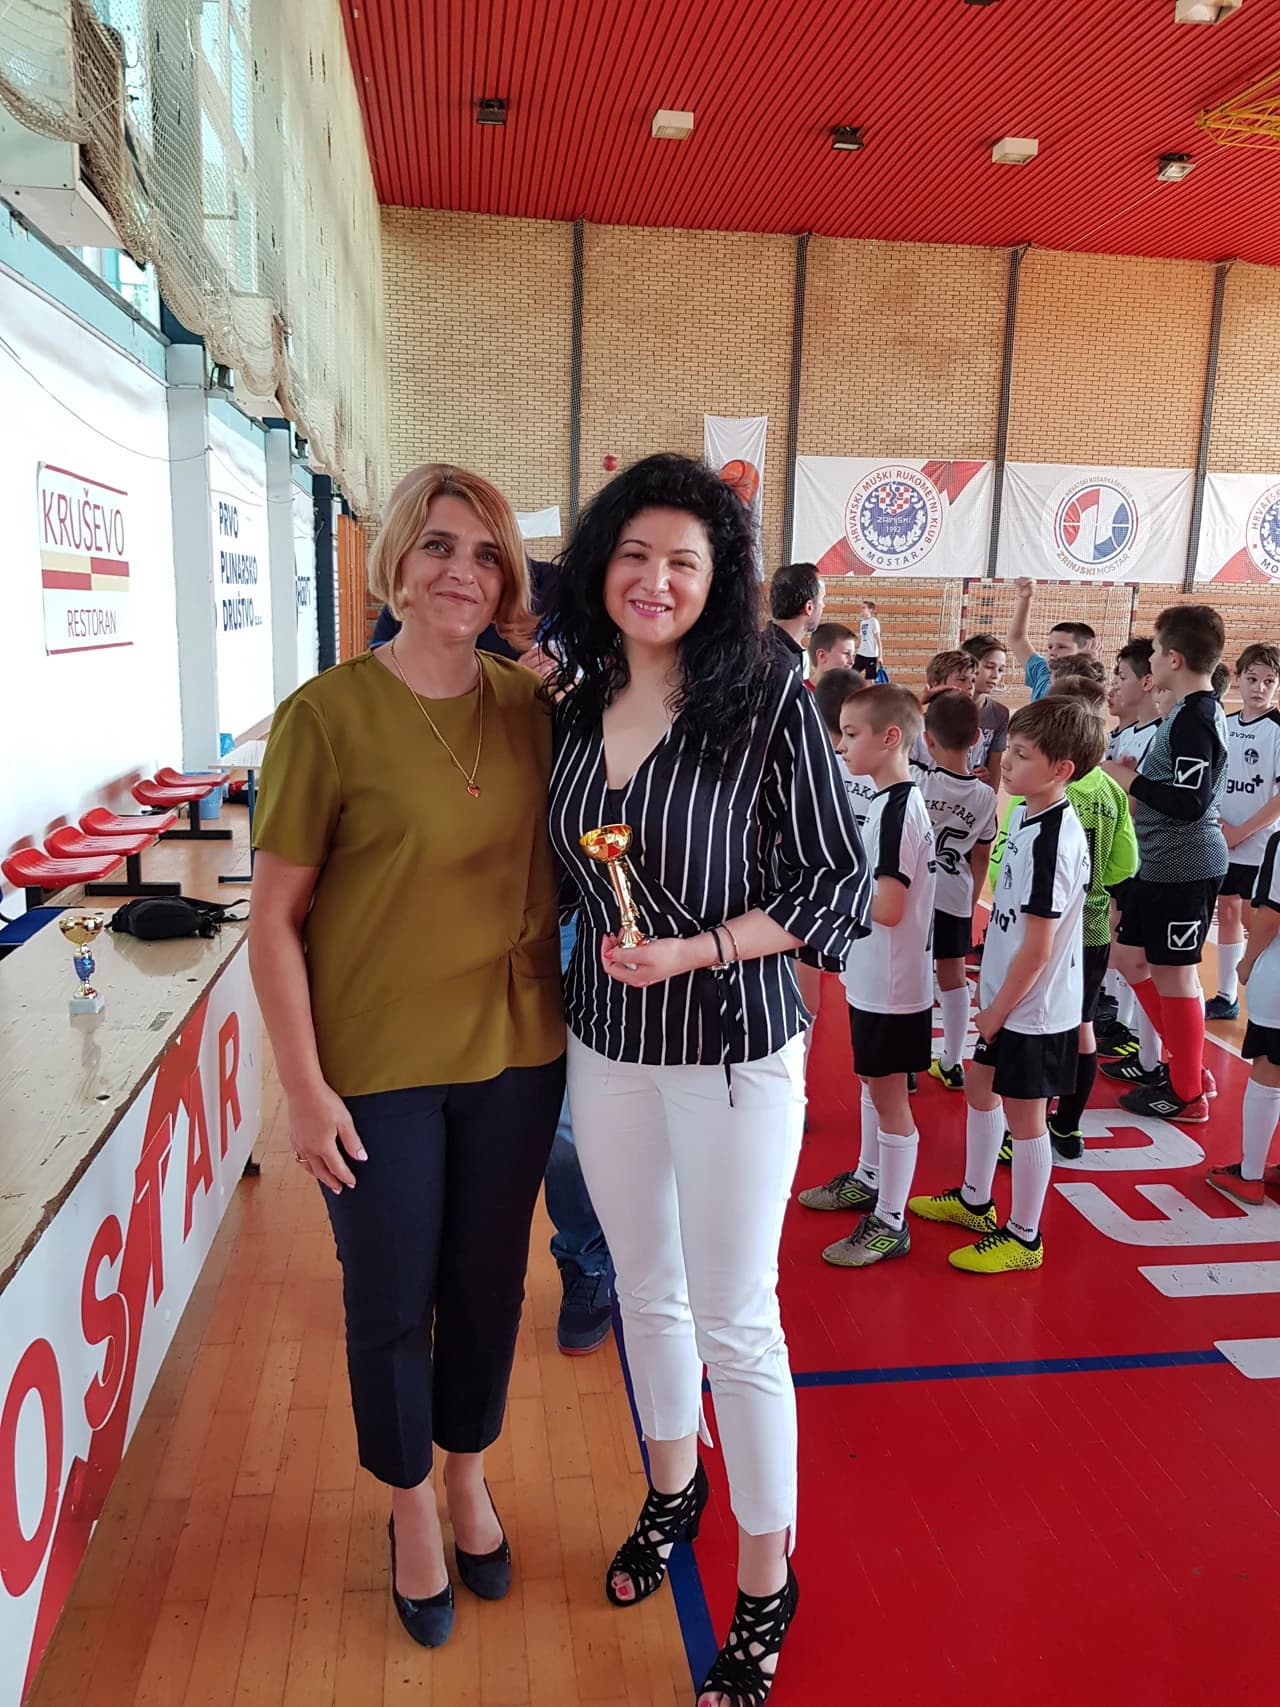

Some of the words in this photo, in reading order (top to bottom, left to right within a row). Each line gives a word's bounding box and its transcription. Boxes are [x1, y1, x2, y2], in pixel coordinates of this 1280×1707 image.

[42, 487, 125, 556] KRUŠEVO
[218, 501, 239, 539] PRVO
[849, 492, 864, 543] HRVATSKI
[862, 470, 892, 492] MUŠKI
[896, 470, 938, 513] RUKOMETNI
[925, 518, 938, 544] KLUB
[220, 550, 258, 584] PLINARSKO
[866, 551, 919, 567] MOSTAR
[1056, 551, 1096, 576] ZRINJSKI
[1096, 553, 1130, 575] MOSTAR
[67, 609, 117, 638] RESTORAN
[222, 591, 254, 632] DRUŠTVO
[924, 799, 977, 829] IKI-TAKA
